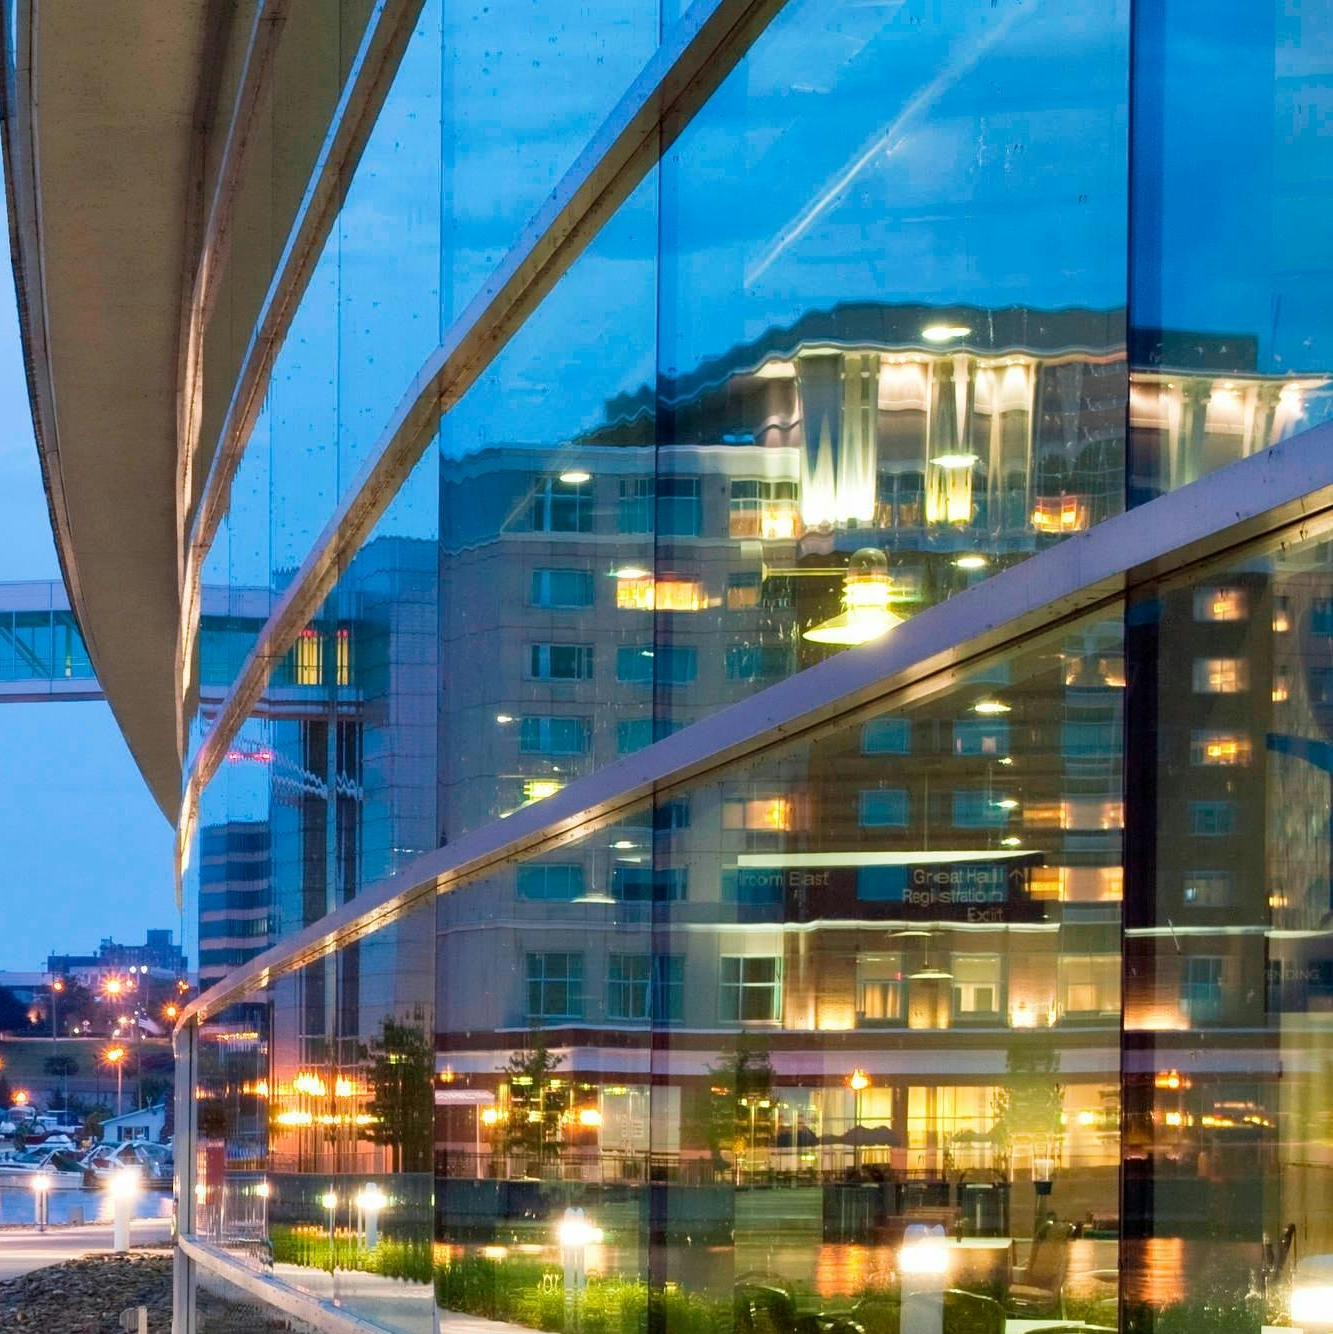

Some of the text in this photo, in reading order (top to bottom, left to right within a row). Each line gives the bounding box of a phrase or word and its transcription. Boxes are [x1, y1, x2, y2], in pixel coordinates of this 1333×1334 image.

[789, 871, 830, 887] East
[913, 866, 1004, 884] Great Hall
[902, 887, 1004, 907] Registration
[967, 906, 1004, 922] Exit
